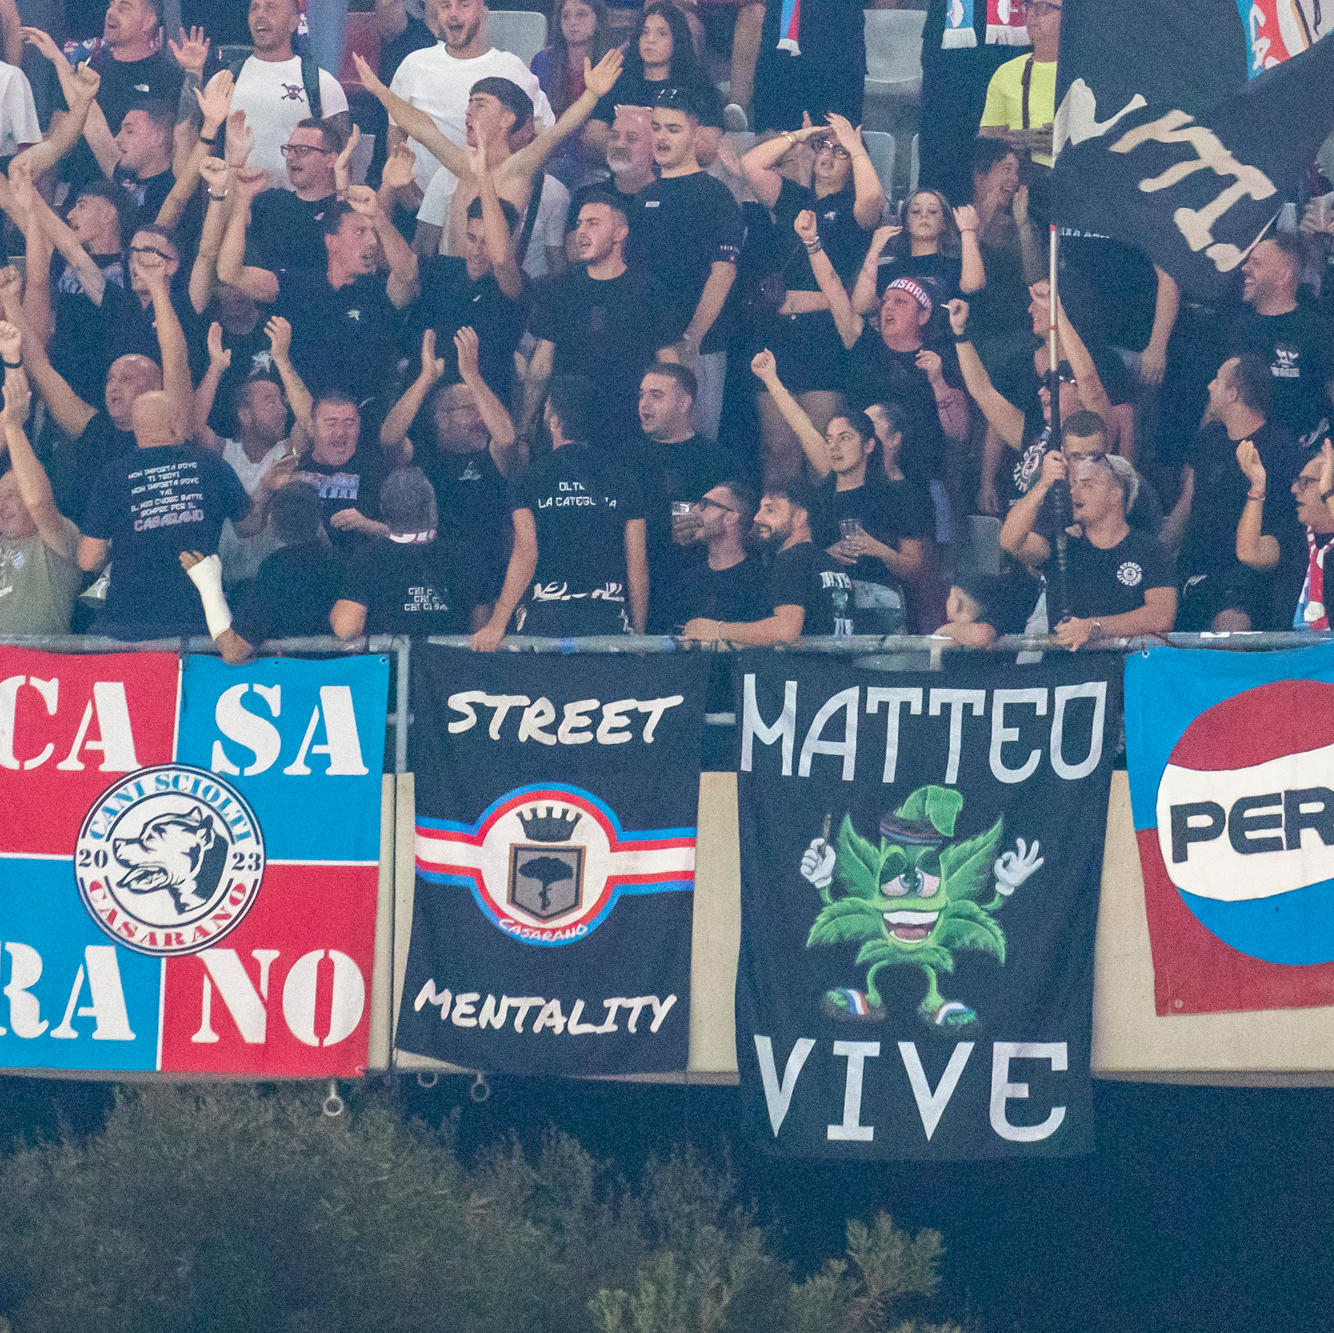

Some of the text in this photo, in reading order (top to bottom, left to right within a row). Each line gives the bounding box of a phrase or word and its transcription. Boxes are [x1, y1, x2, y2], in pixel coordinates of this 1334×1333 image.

[538, 496, 553, 509] LA
[210, 682, 369, 777] SA
[447, 690, 685, 746] STREET
[740, 673, 1108, 785] MATTEO
[88, 773, 253, 844] CANI SCIOLTI
[78, 849, 263, 873] 20 23
[88, 879, 248, 949] CASARANO
[498, 917, 589, 944] CASARANO
[190, 948, 366, 1048] NO
[414, 978, 677, 1035] MENTALITY
[753, 1035, 1069, 1142] VIVE
